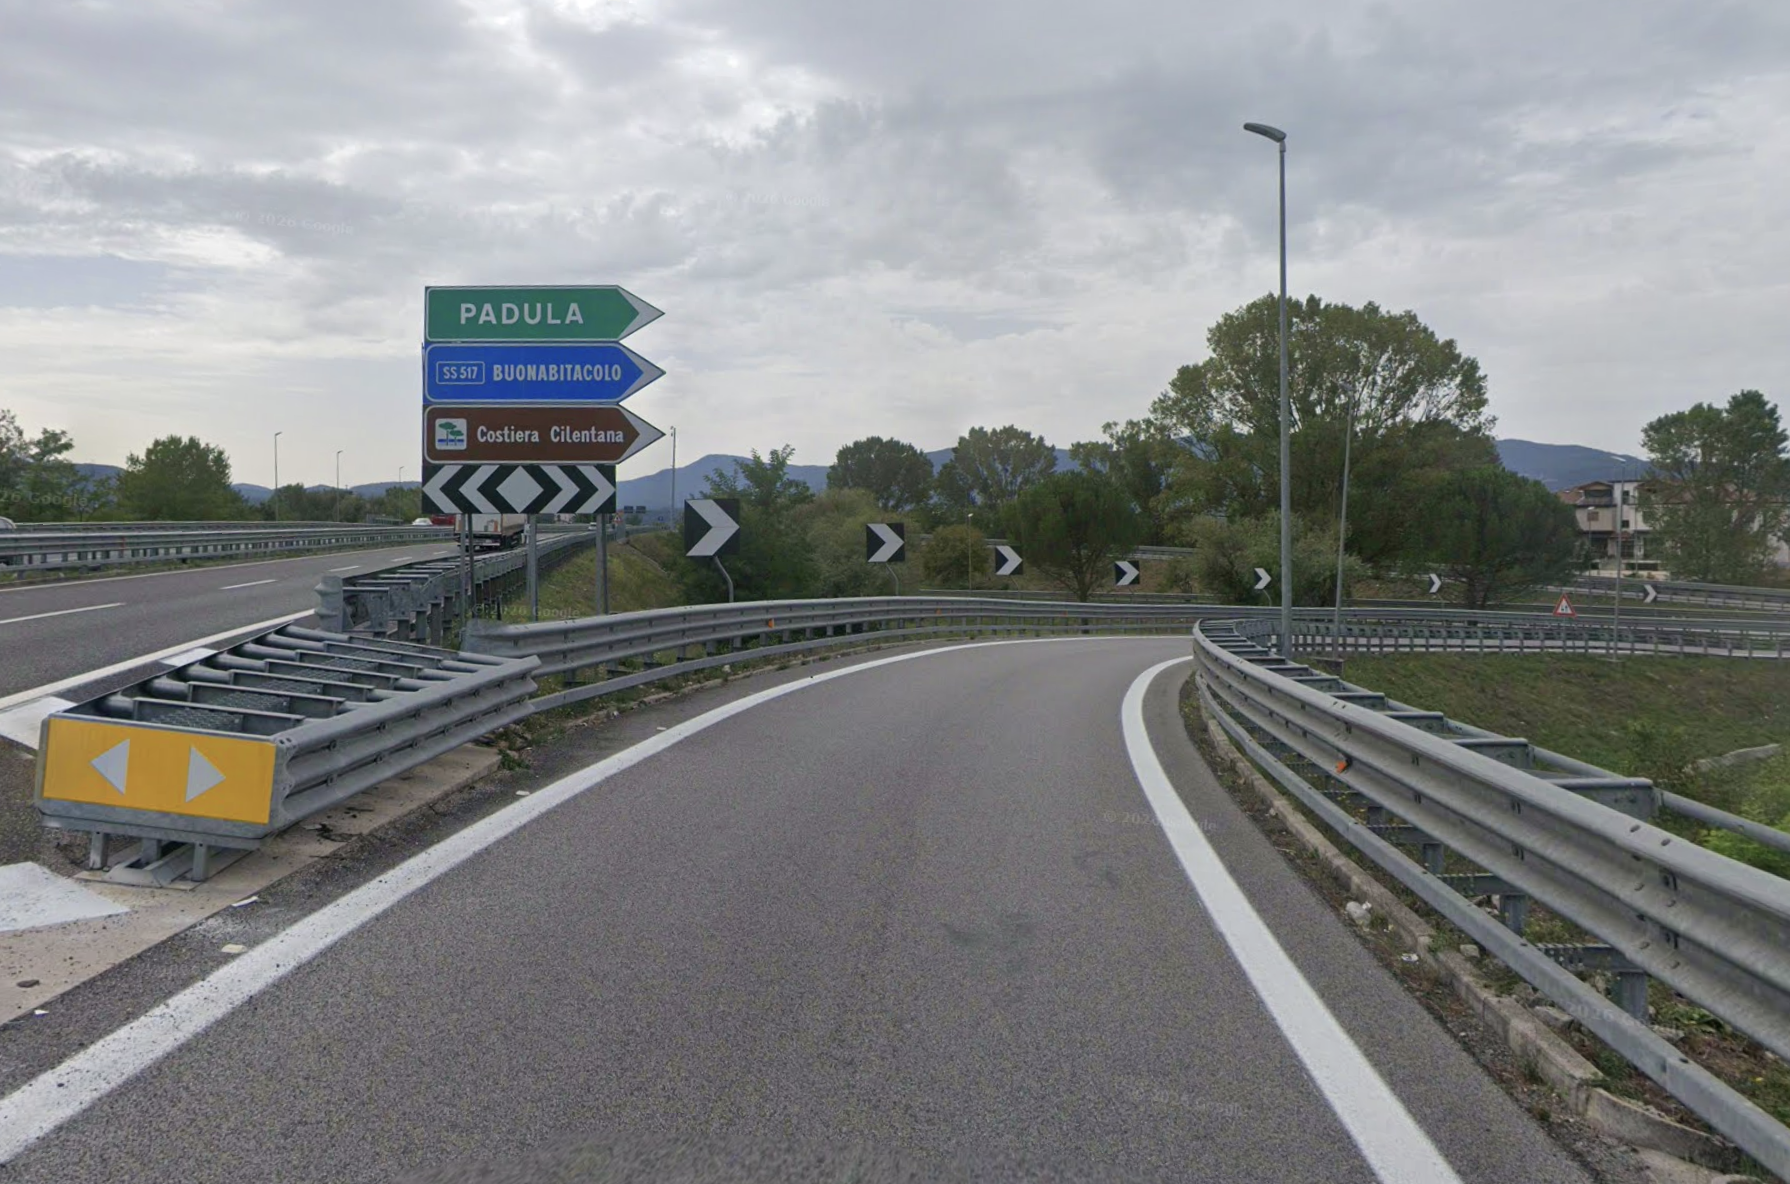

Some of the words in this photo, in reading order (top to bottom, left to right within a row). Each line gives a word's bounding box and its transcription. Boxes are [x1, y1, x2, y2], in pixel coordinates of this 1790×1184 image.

[459, 303, 584, 325] PADULA
[443, 366, 458, 380] SS
[460, 366, 478, 380] 517
[493, 364, 622, 381] BUONABITACOLO
[477, 425, 540, 443] Costiera
[550, 425, 624, 443] Cilentana
